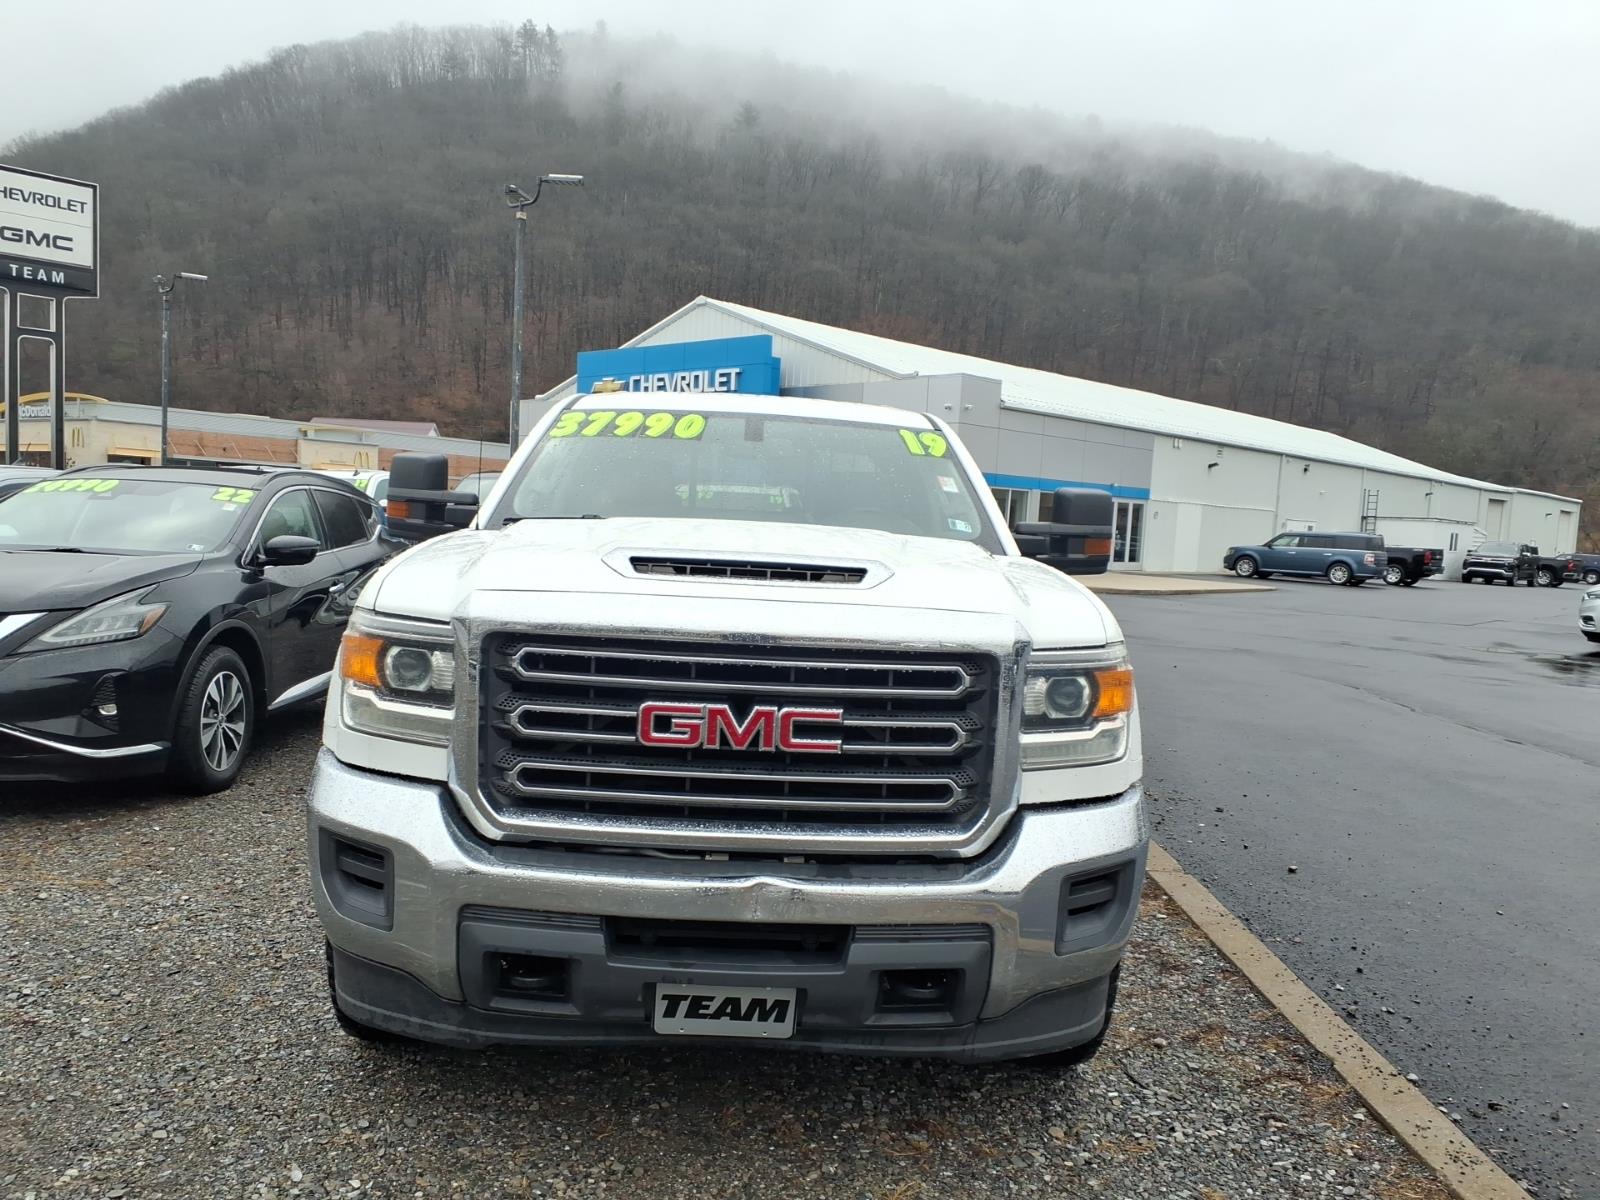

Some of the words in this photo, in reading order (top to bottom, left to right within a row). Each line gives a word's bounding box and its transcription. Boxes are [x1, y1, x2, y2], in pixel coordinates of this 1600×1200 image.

[0, 186, 88, 214] HEVROLET
[0, 225, 74, 252] GMC
[9, 263, 65, 284] TEAM
[629, 367, 742, 393] CHEVROLET
[19, 404, 52, 417] cDonald
[548, 410, 706, 439] 37990
[898, 429, 947, 457] 19
[212, 486, 254, 503] 22
[637, 701, 844, 754] GMC
[660, 994, 791, 1024] TEAM
